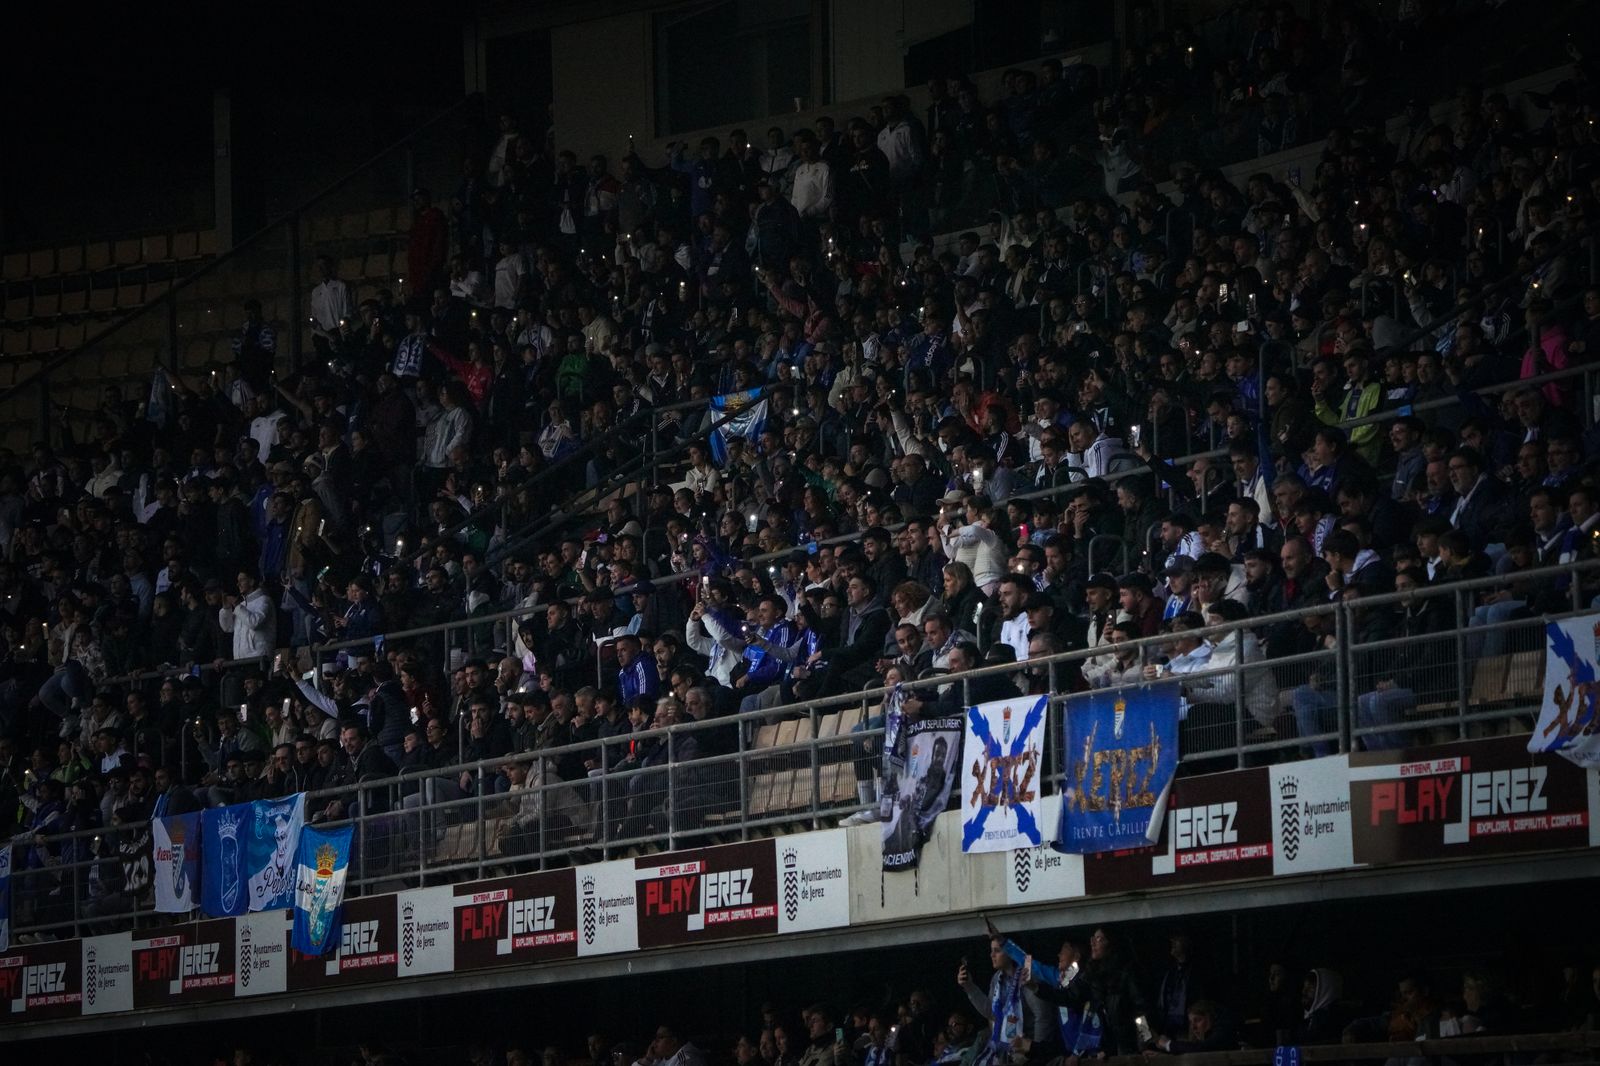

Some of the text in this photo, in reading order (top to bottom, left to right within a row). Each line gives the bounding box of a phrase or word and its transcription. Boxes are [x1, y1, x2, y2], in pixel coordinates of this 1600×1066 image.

[1304, 797, 1350, 820] Ayuntamien
[1371, 765, 1548, 844] PLAY JEREZ
[1073, 820, 1150, 840] FRENTE CAPILLIT
[1304, 819, 1335, 838] de Jerez
[1152, 801, 1238, 876] JEREZ
[1035, 854, 1061, 871] de Jerez
[801, 866, 842, 884] Ayuntamiento
[599, 894, 635, 911] Ayuntamiento
[646, 868, 754, 931] PLAY JEREZ
[801, 886, 825, 901] de Jerez
[416, 919, 450, 933] Ayuntamiento
[461, 895, 556, 955] PLAY JEREZ
[599, 912, 619, 926] de Jerez
[253, 942, 283, 955] Ayuntamiento
[325, 920, 379, 976] JEREZ
[416, 937, 435, 950] de Jerez
[98, 962, 131, 977] Ayuntamiento
[138, 942, 220, 994] PLAY JEREZ
[253, 958, 270, 971] de Jerez
[11, 962, 67, 1013] JEREZ
[103, 979, 116, 991] Jerez
